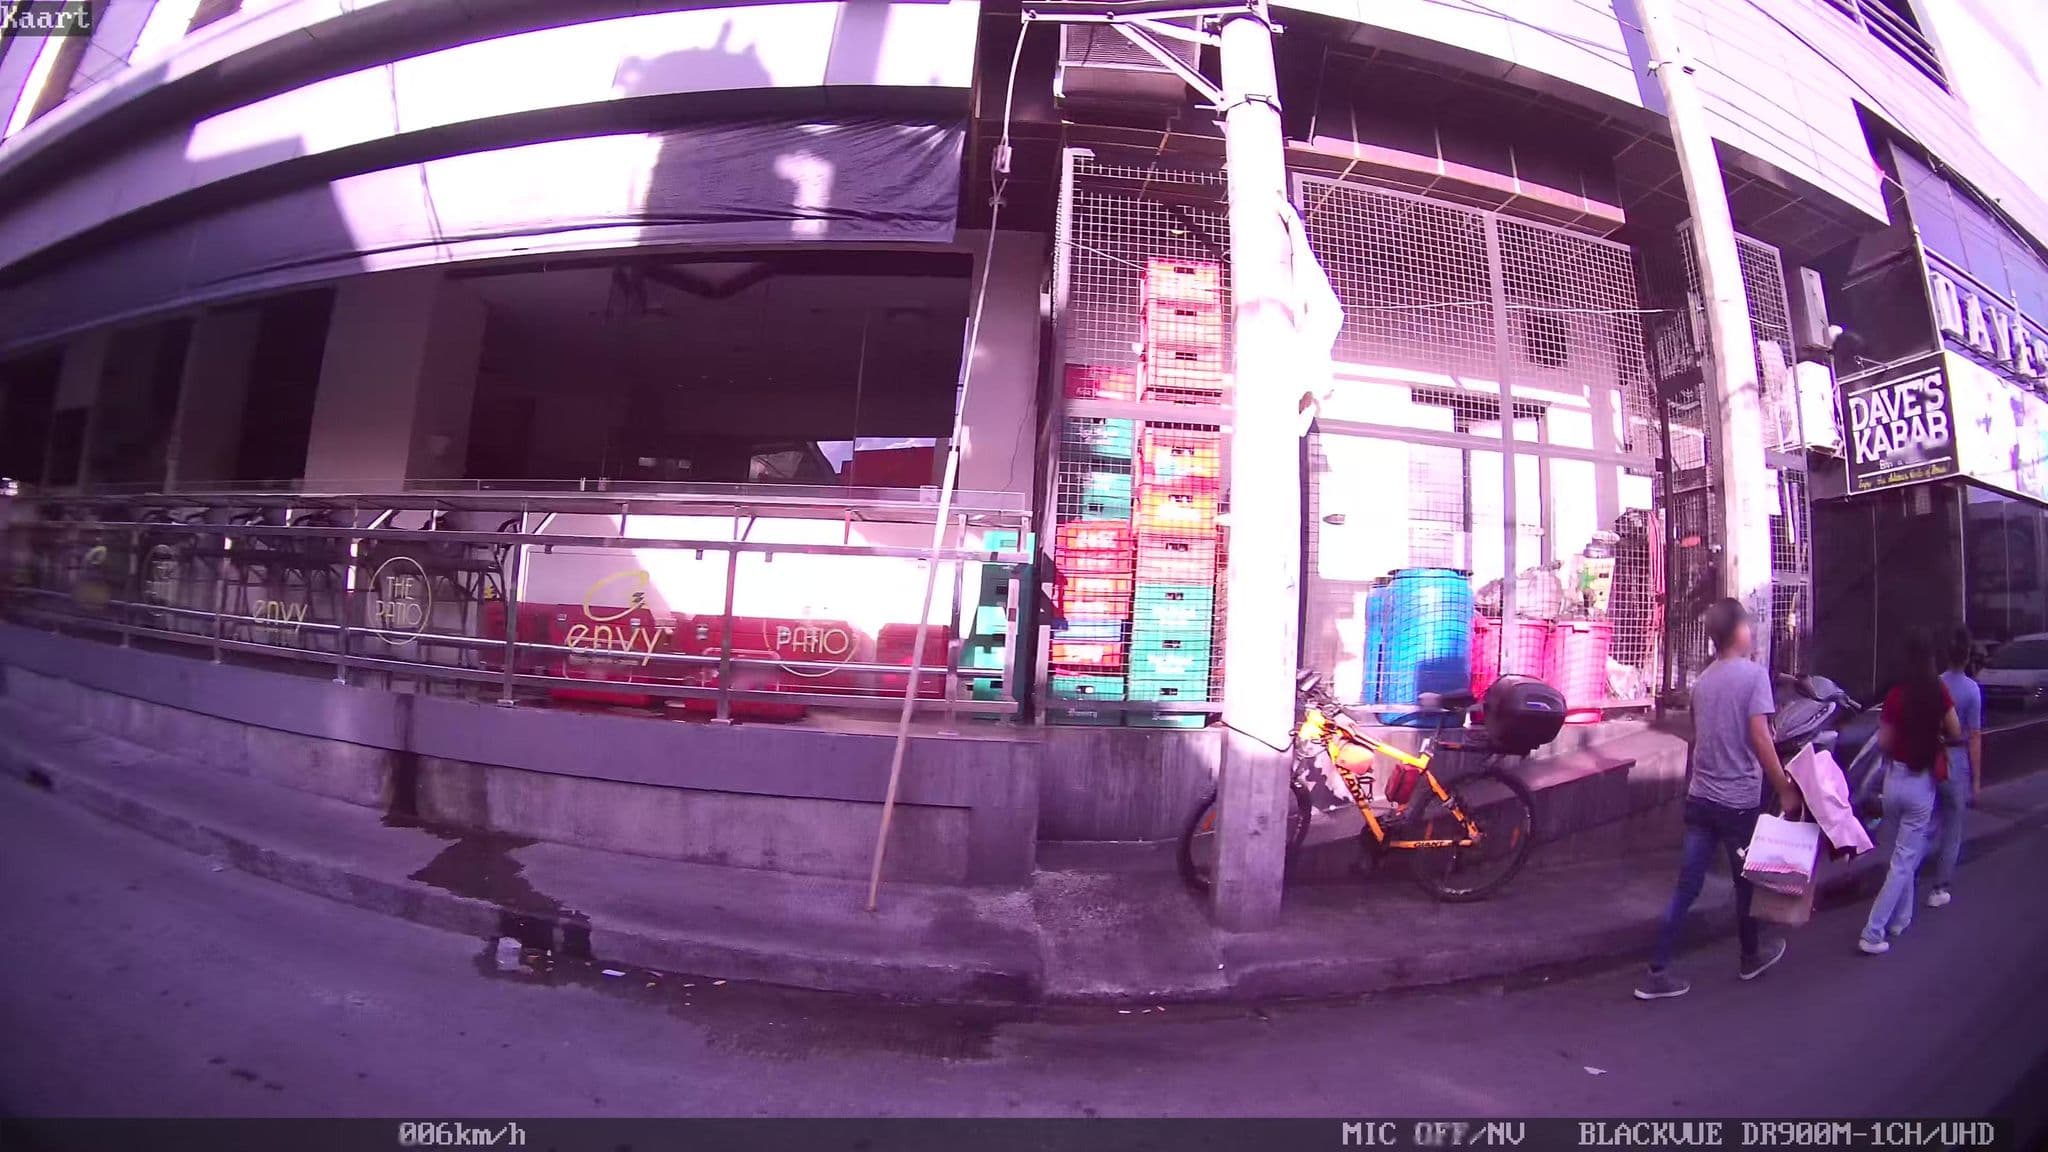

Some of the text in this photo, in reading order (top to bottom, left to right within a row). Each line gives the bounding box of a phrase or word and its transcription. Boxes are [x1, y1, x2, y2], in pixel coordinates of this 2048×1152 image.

[1848, 373, 1944, 431] DAVE'S
[1853, 411, 1949, 464] KABAB
[386, 576, 415, 600] THE
[253, 599, 308, 633] envy
[375, 600, 423, 625] PATIO
[565, 624, 661, 667] envy
[776, 625, 849, 654] PATIO
